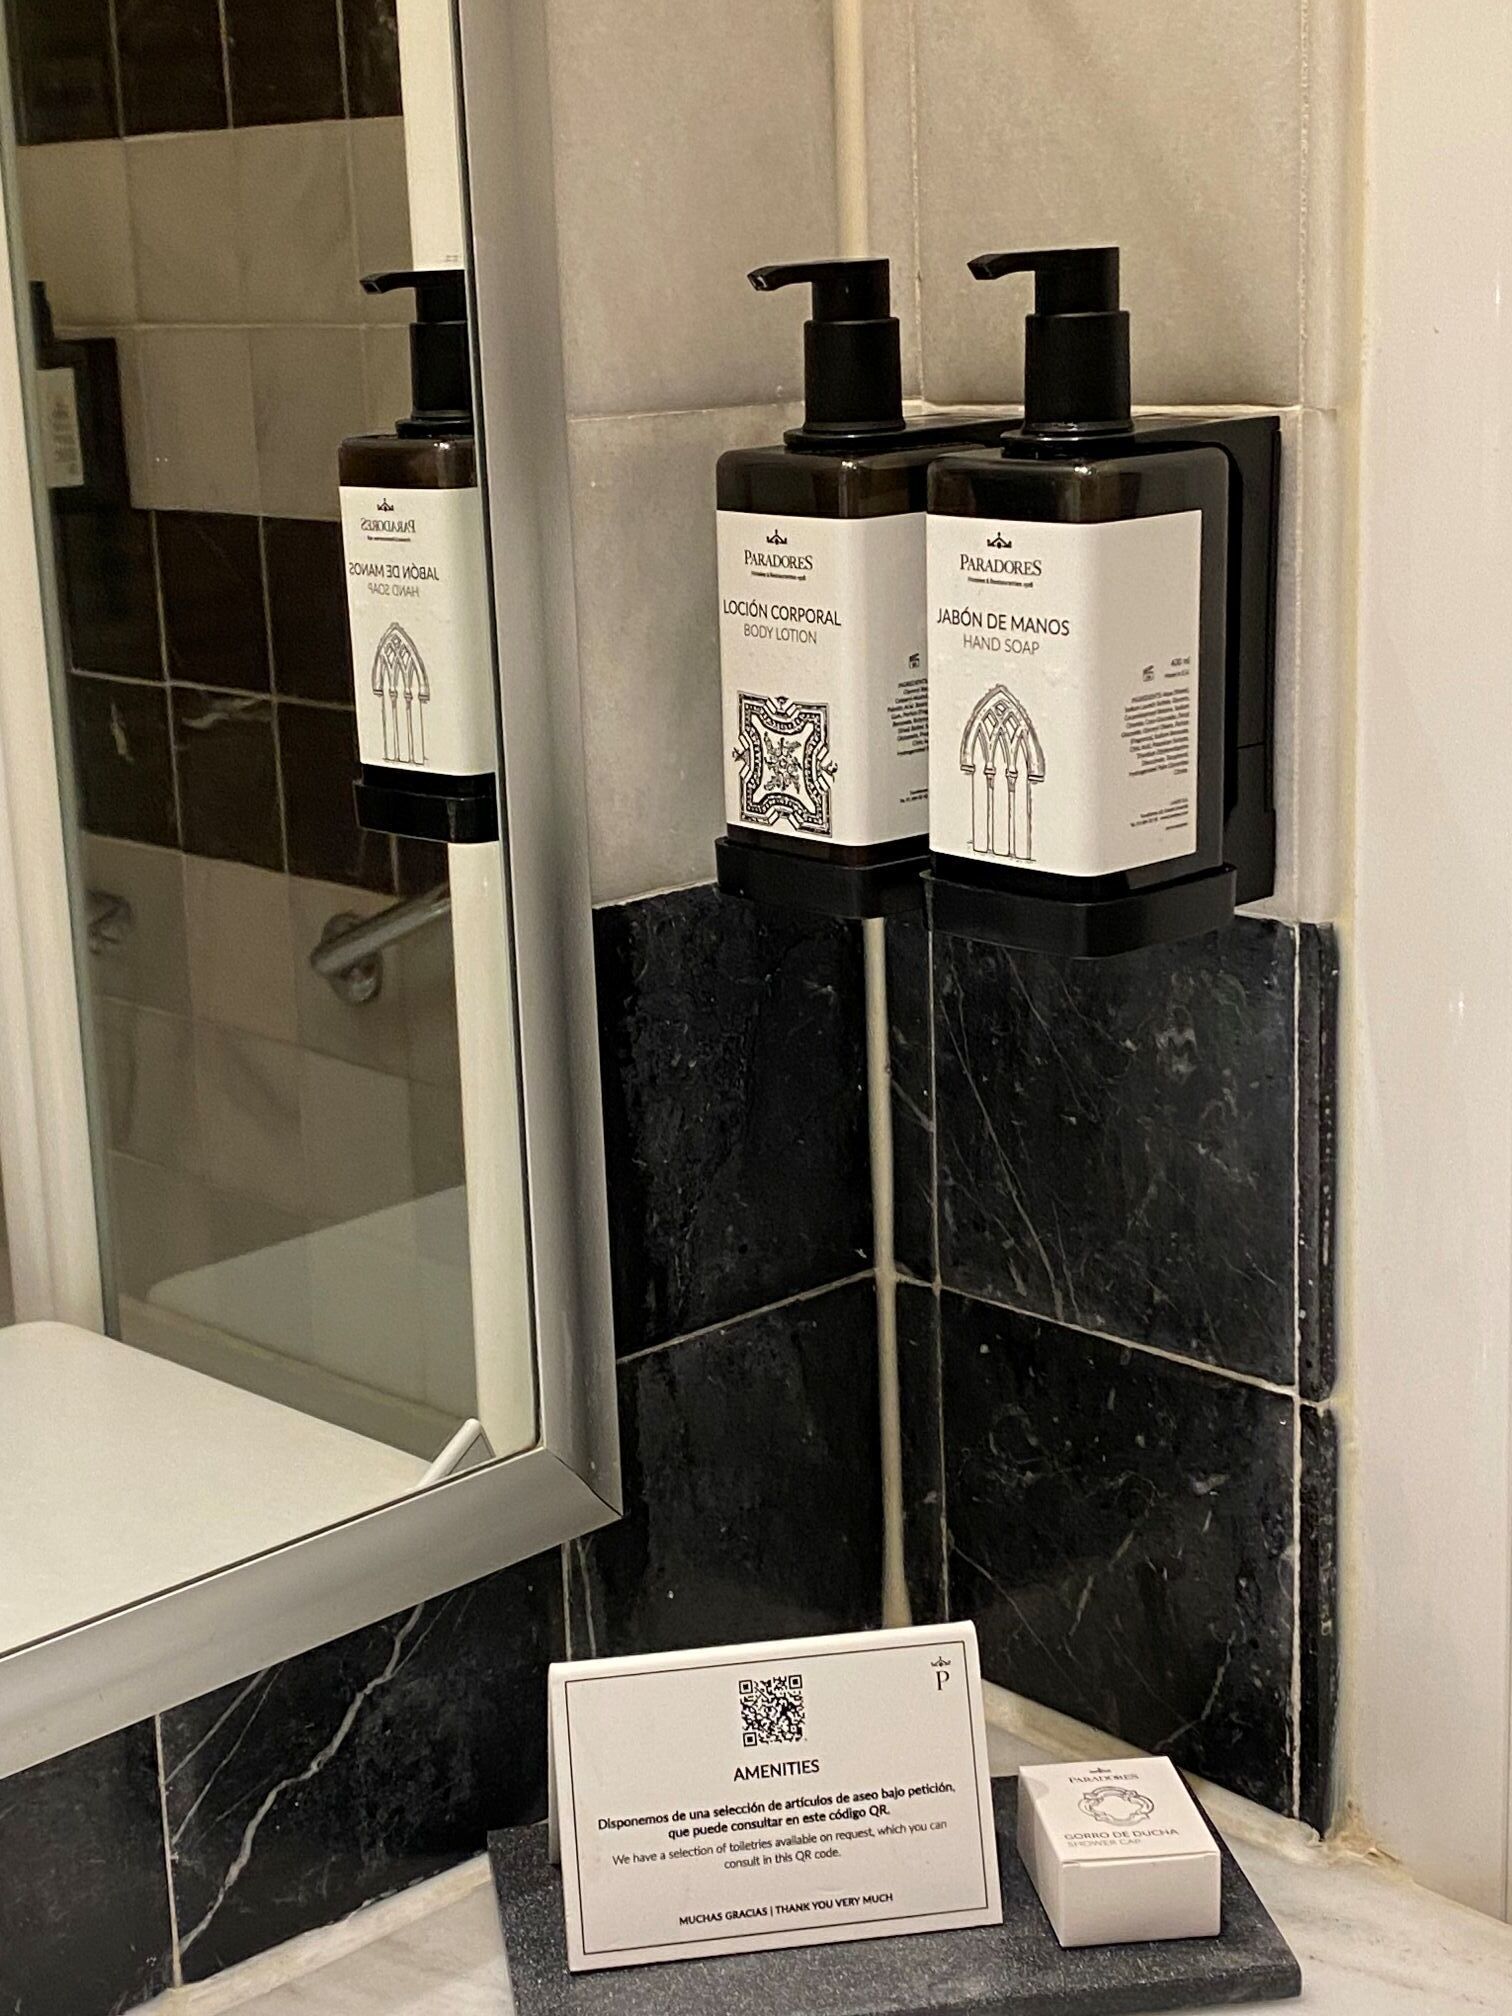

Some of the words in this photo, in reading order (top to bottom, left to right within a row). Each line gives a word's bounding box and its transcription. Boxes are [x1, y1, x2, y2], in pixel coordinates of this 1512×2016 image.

[744, 549, 813, 570] PARADORES
[960, 554, 1042, 576] PARADORES
[723, 599, 768, 619] LOCIÓN
[771, 605, 841, 626] CORPORAL
[937, 606, 982, 628] JABÓN
[987, 613, 1006, 630] DE
[1011, 616, 1070, 636] MANOS
[744, 623, 773, 639] BODY
[776, 627, 817, 644] LOTION
[963, 634, 1000, 652] HAND
[1004, 638, 1040, 655] SOAP
[936, 1670, 949, 1691] P
[733, 1759, 820, 1781] AMENITIES
[598, 1815, 669, 1831] Disponemos
[672, 1811, 686, 1822] de
[689, 1810, 710, 1820] una
[713, 1803, 765, 1817] selección
[768, 1800, 782, 1812] de
[785, 1795, 833, 1810] artículos
[836, 1793, 850, 1804] de
[853, 1792, 878, 1802] aseo
[881, 1786, 905, 1800] bajo
[908, 1782, 956, 1798] petición,
[668, 1828, 689, 1840] que
[693, 1823, 728, 1838] puede
[731, 1817, 782, 1830] consultar
[786, 1817, 799, 1825] en
[803, 1812, 826, 1822] este
[829, 1808, 866, 1820] código
[869, 1804, 890, 1817] QR.
[612, 1855, 630, 1865] We
[633, 1851, 657, 1863] have
[669, 1846, 713, 1859] selection
[716, 1843, 726, 1853] of
[730, 1839, 772, 1852] toiletries
[775, 1832, 817, 1848] available
[820, 1833, 832, 1841] on
[836, 1827, 875, 1841] request,
[878, 1823, 906, 1835] which
[909, 1823, 927, 1834] you
[930, 1820, 947, 1830] can
[1064, 1832, 1110, 1840] GORRO
[1133, 1829, 1179, 1837] DUCHA
[1067, 1839, 1117, 1847] SHOWER
[724, 1855, 760, 1869] consult
[763, 1855, 772, 1865] in
[775, 1853, 792, 1864] this
[796, 1852, 811, 1862] QR
[815, 1848, 841, 1859] code.
[679, 1912, 722, 1926] MUCHAS
[725, 1907, 767, 1920] GRACIAS
[776, 1901, 810, 1914] THANK
[812, 1900, 833, 1910] YOU
[836, 1897, 861, 1908] VERY
[863, 1893, 893, 1905] MUCH
